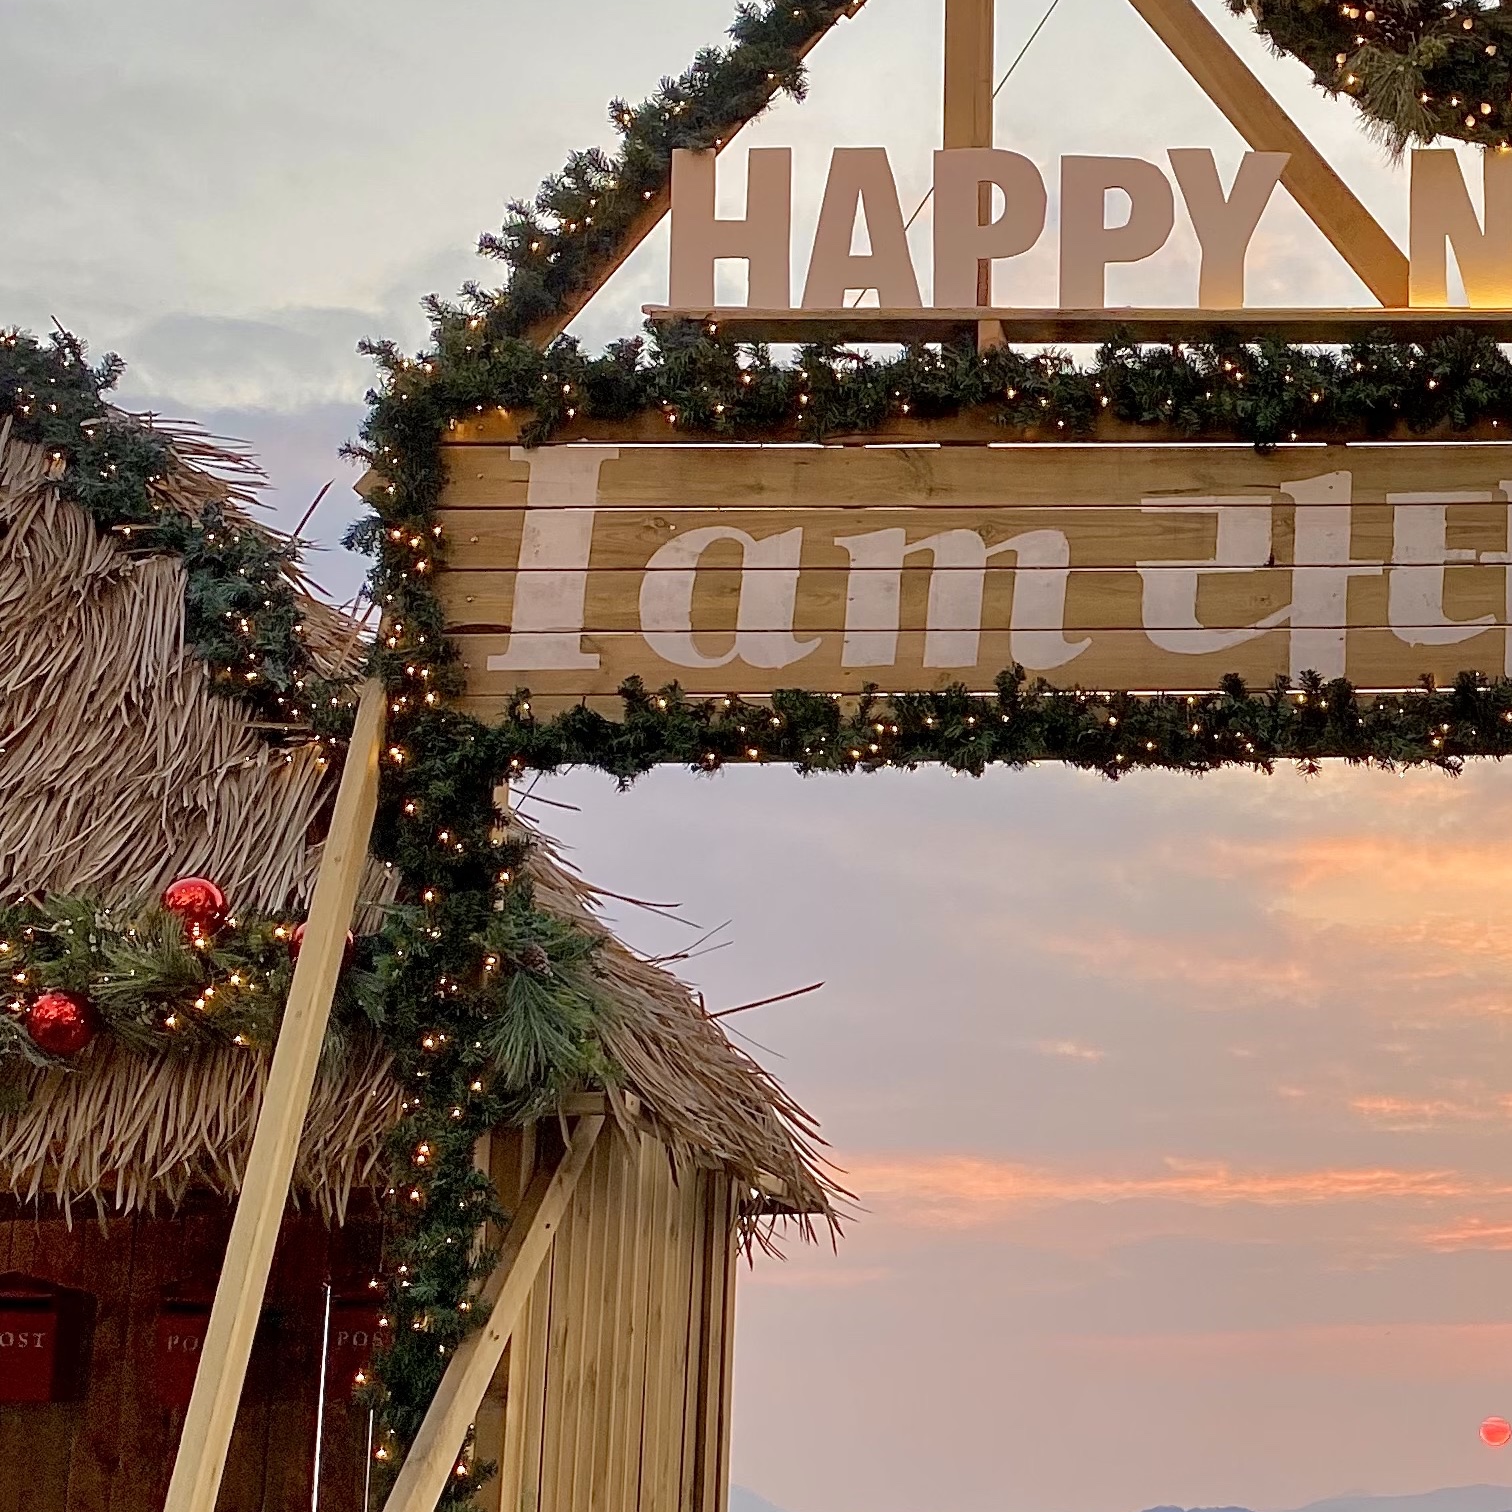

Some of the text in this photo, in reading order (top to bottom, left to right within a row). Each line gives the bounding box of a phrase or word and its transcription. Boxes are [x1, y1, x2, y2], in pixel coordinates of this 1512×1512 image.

[668, 146, 1292, 308] HAPPY
[487, 446, 620, 671] I
[638, 526, 1093, 671] am
[0, 1331, 46, 1348] OST
[167, 1334, 199, 1353] PO
[336, 1330, 390, 1350] POS
